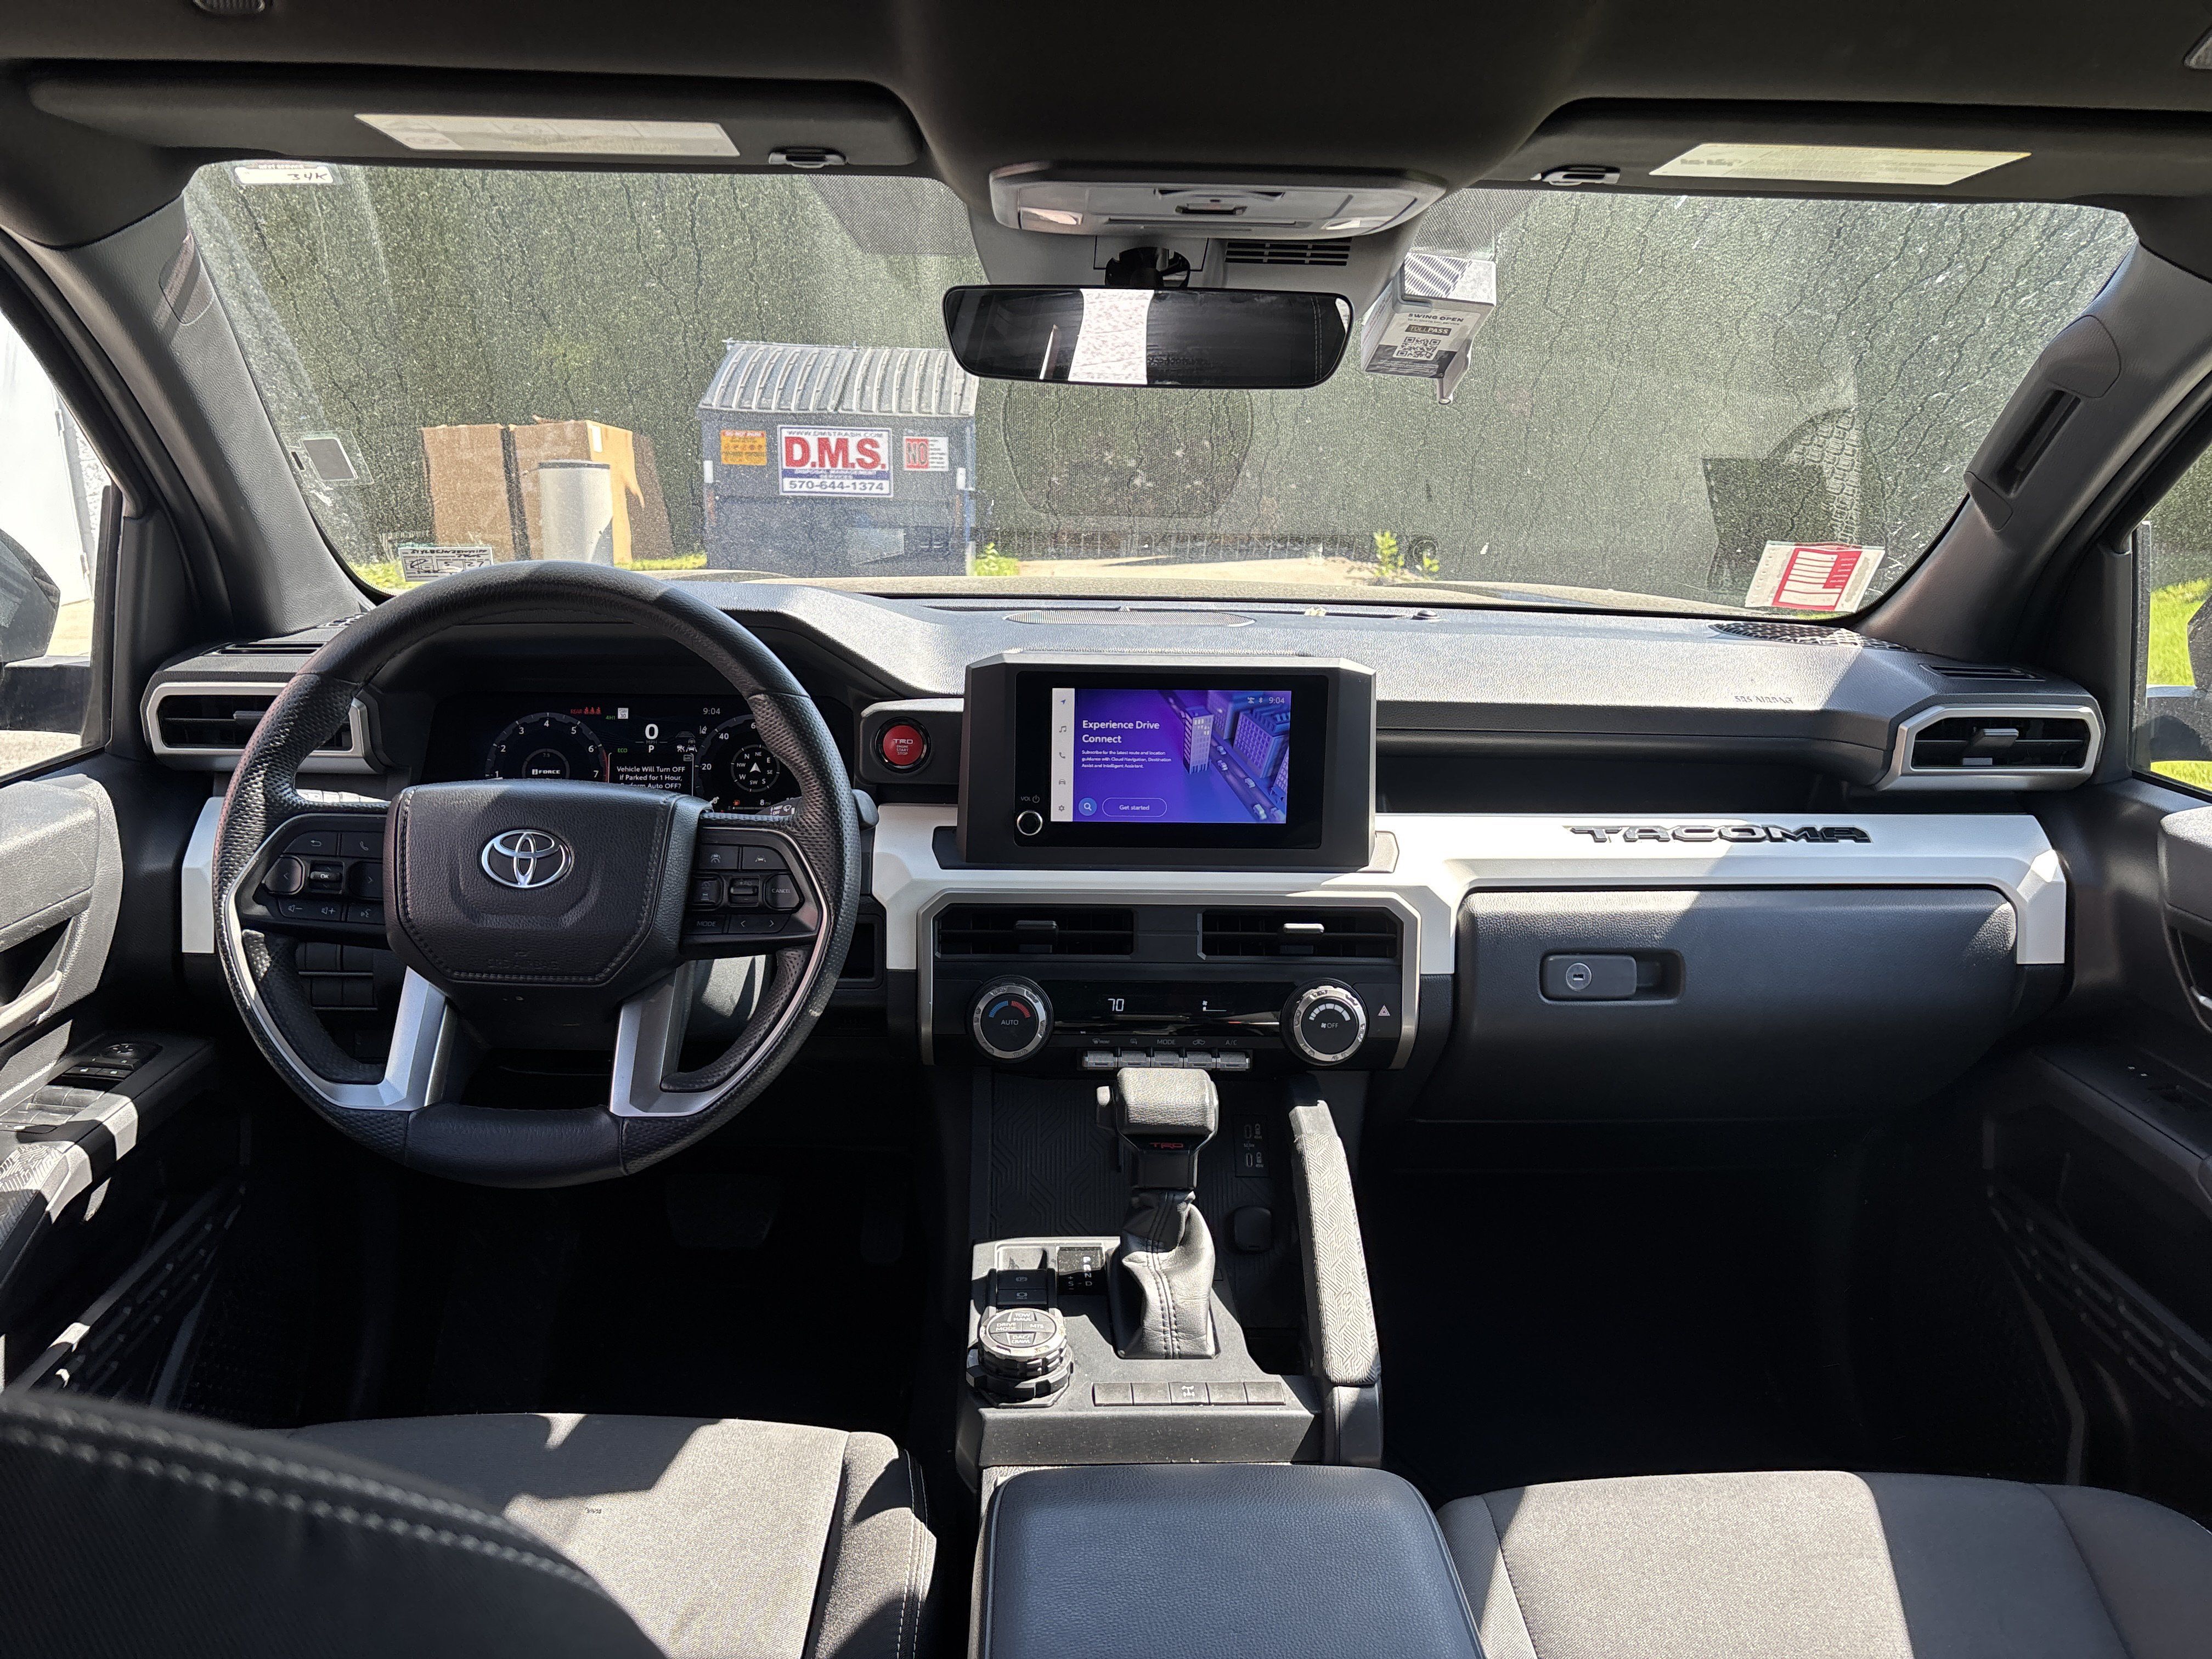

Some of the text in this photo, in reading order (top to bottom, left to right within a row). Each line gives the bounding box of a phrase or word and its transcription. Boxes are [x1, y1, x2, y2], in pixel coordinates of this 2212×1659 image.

[785, 436, 887, 470] D.M.S.
[907, 442, 928, 465] NO
[789, 480, 884, 491] 570-644-1374
[571, 726, 577, 735] 5
[1082, 720, 1160, 730] Experience Drive
[645, 724, 659, 740] 0
[1082, 734, 1122, 743] Connect
[648, 744, 654, 753] P
[1568, 825, 1874, 844] TACOMA
[1107, 998, 1125, 1012] 70
